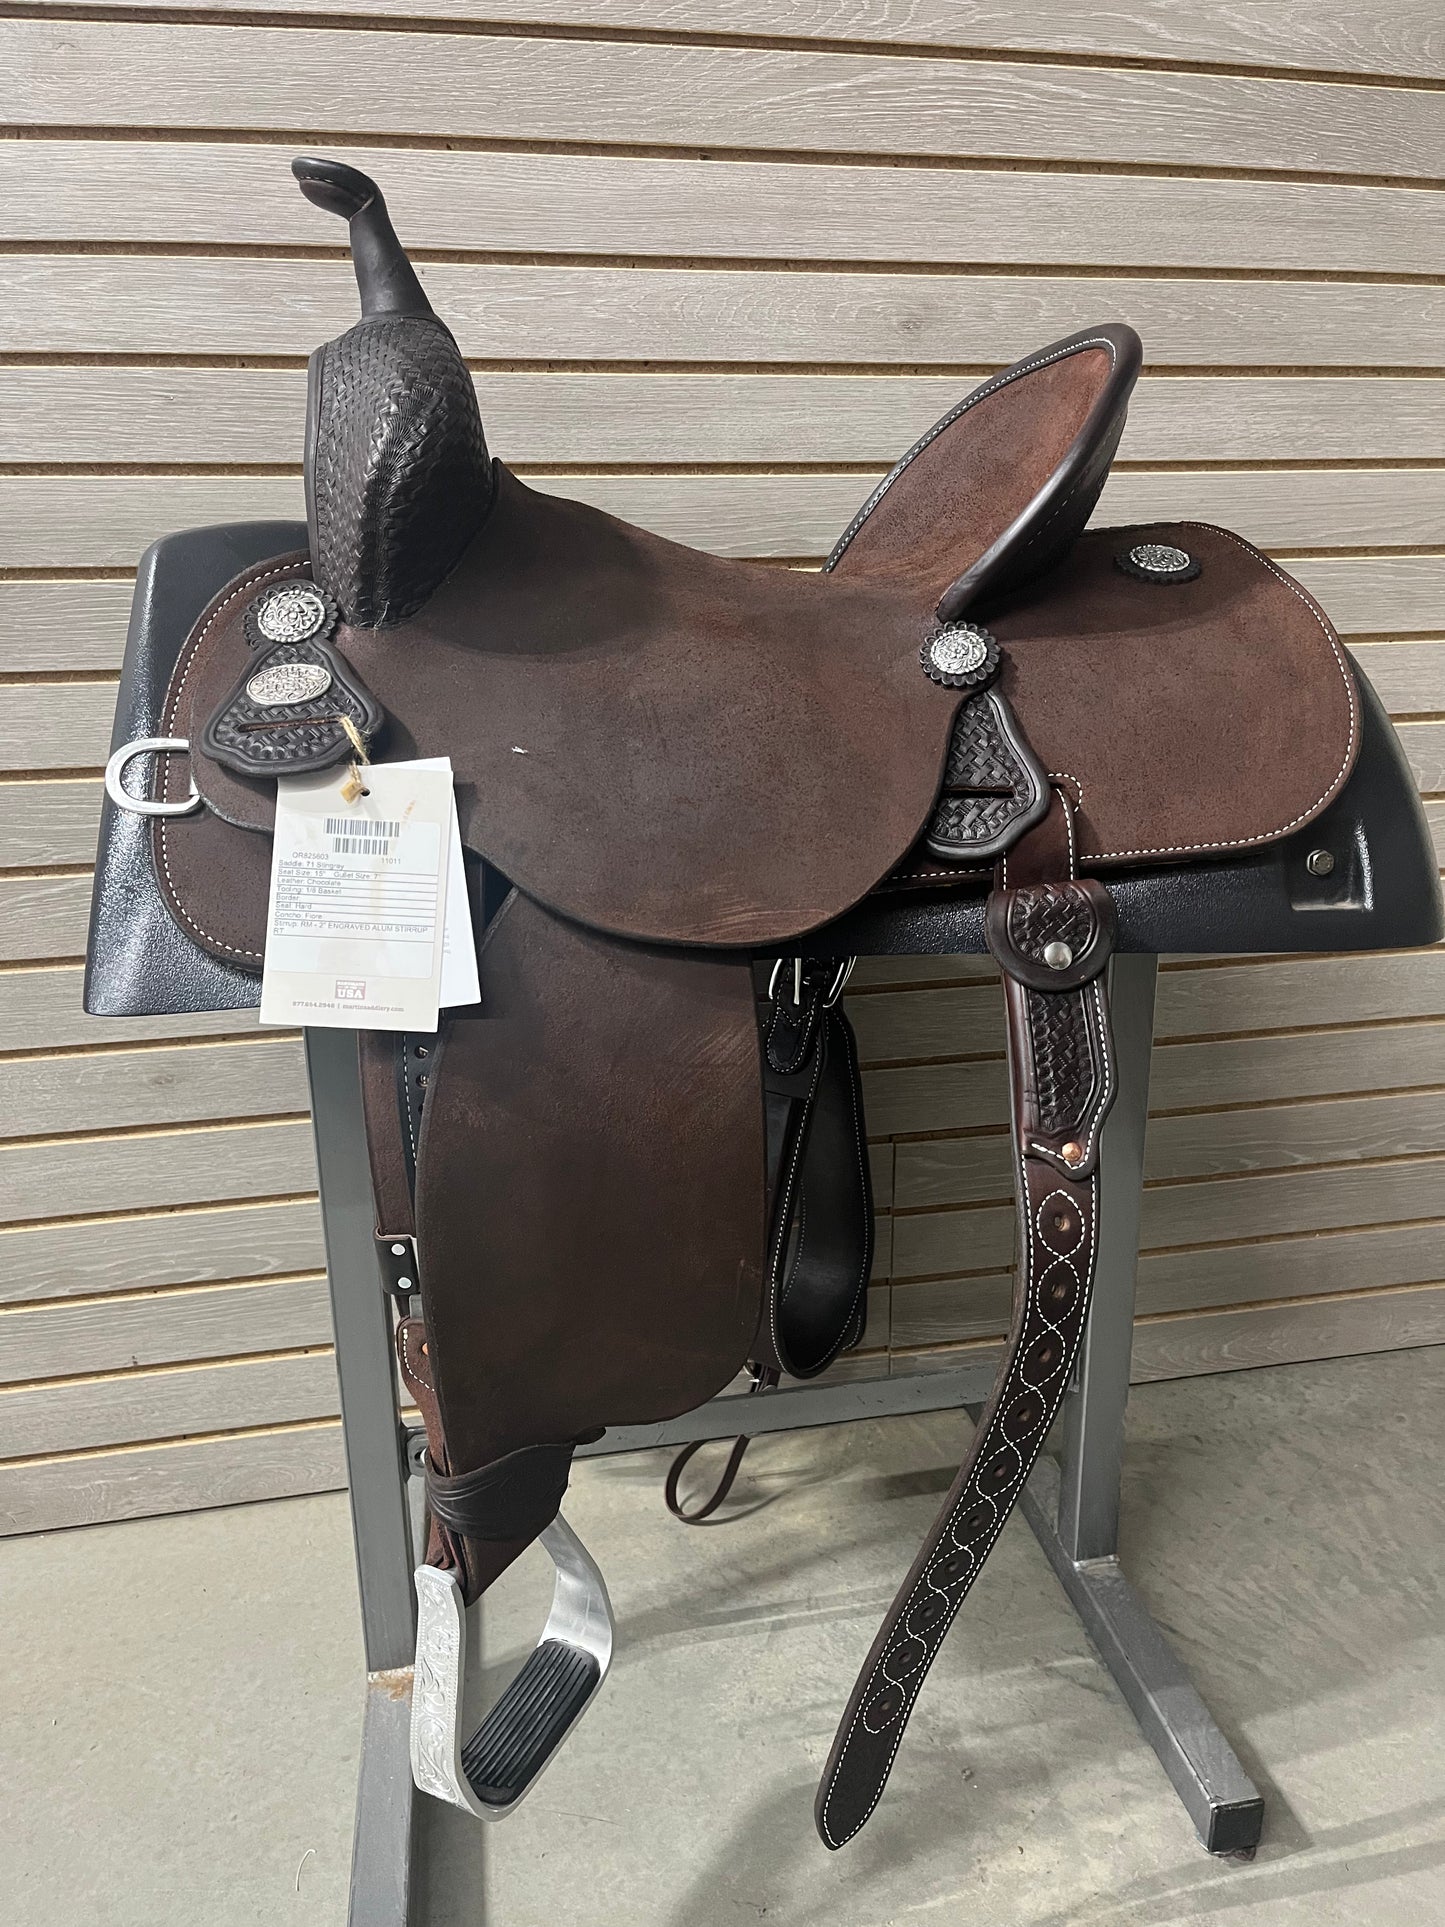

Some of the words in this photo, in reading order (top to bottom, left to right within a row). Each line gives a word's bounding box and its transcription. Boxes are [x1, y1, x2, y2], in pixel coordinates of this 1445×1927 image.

[316, 862, 345, 870] Stingray
[306, 878, 341, 886] Chocolate
[277, 885, 304, 894] Tooling:
[328, 922, 371, 930] ENGRAVED
[394, 925, 428, 933] STIRRUP
[337, 989, 363, 998] USA
